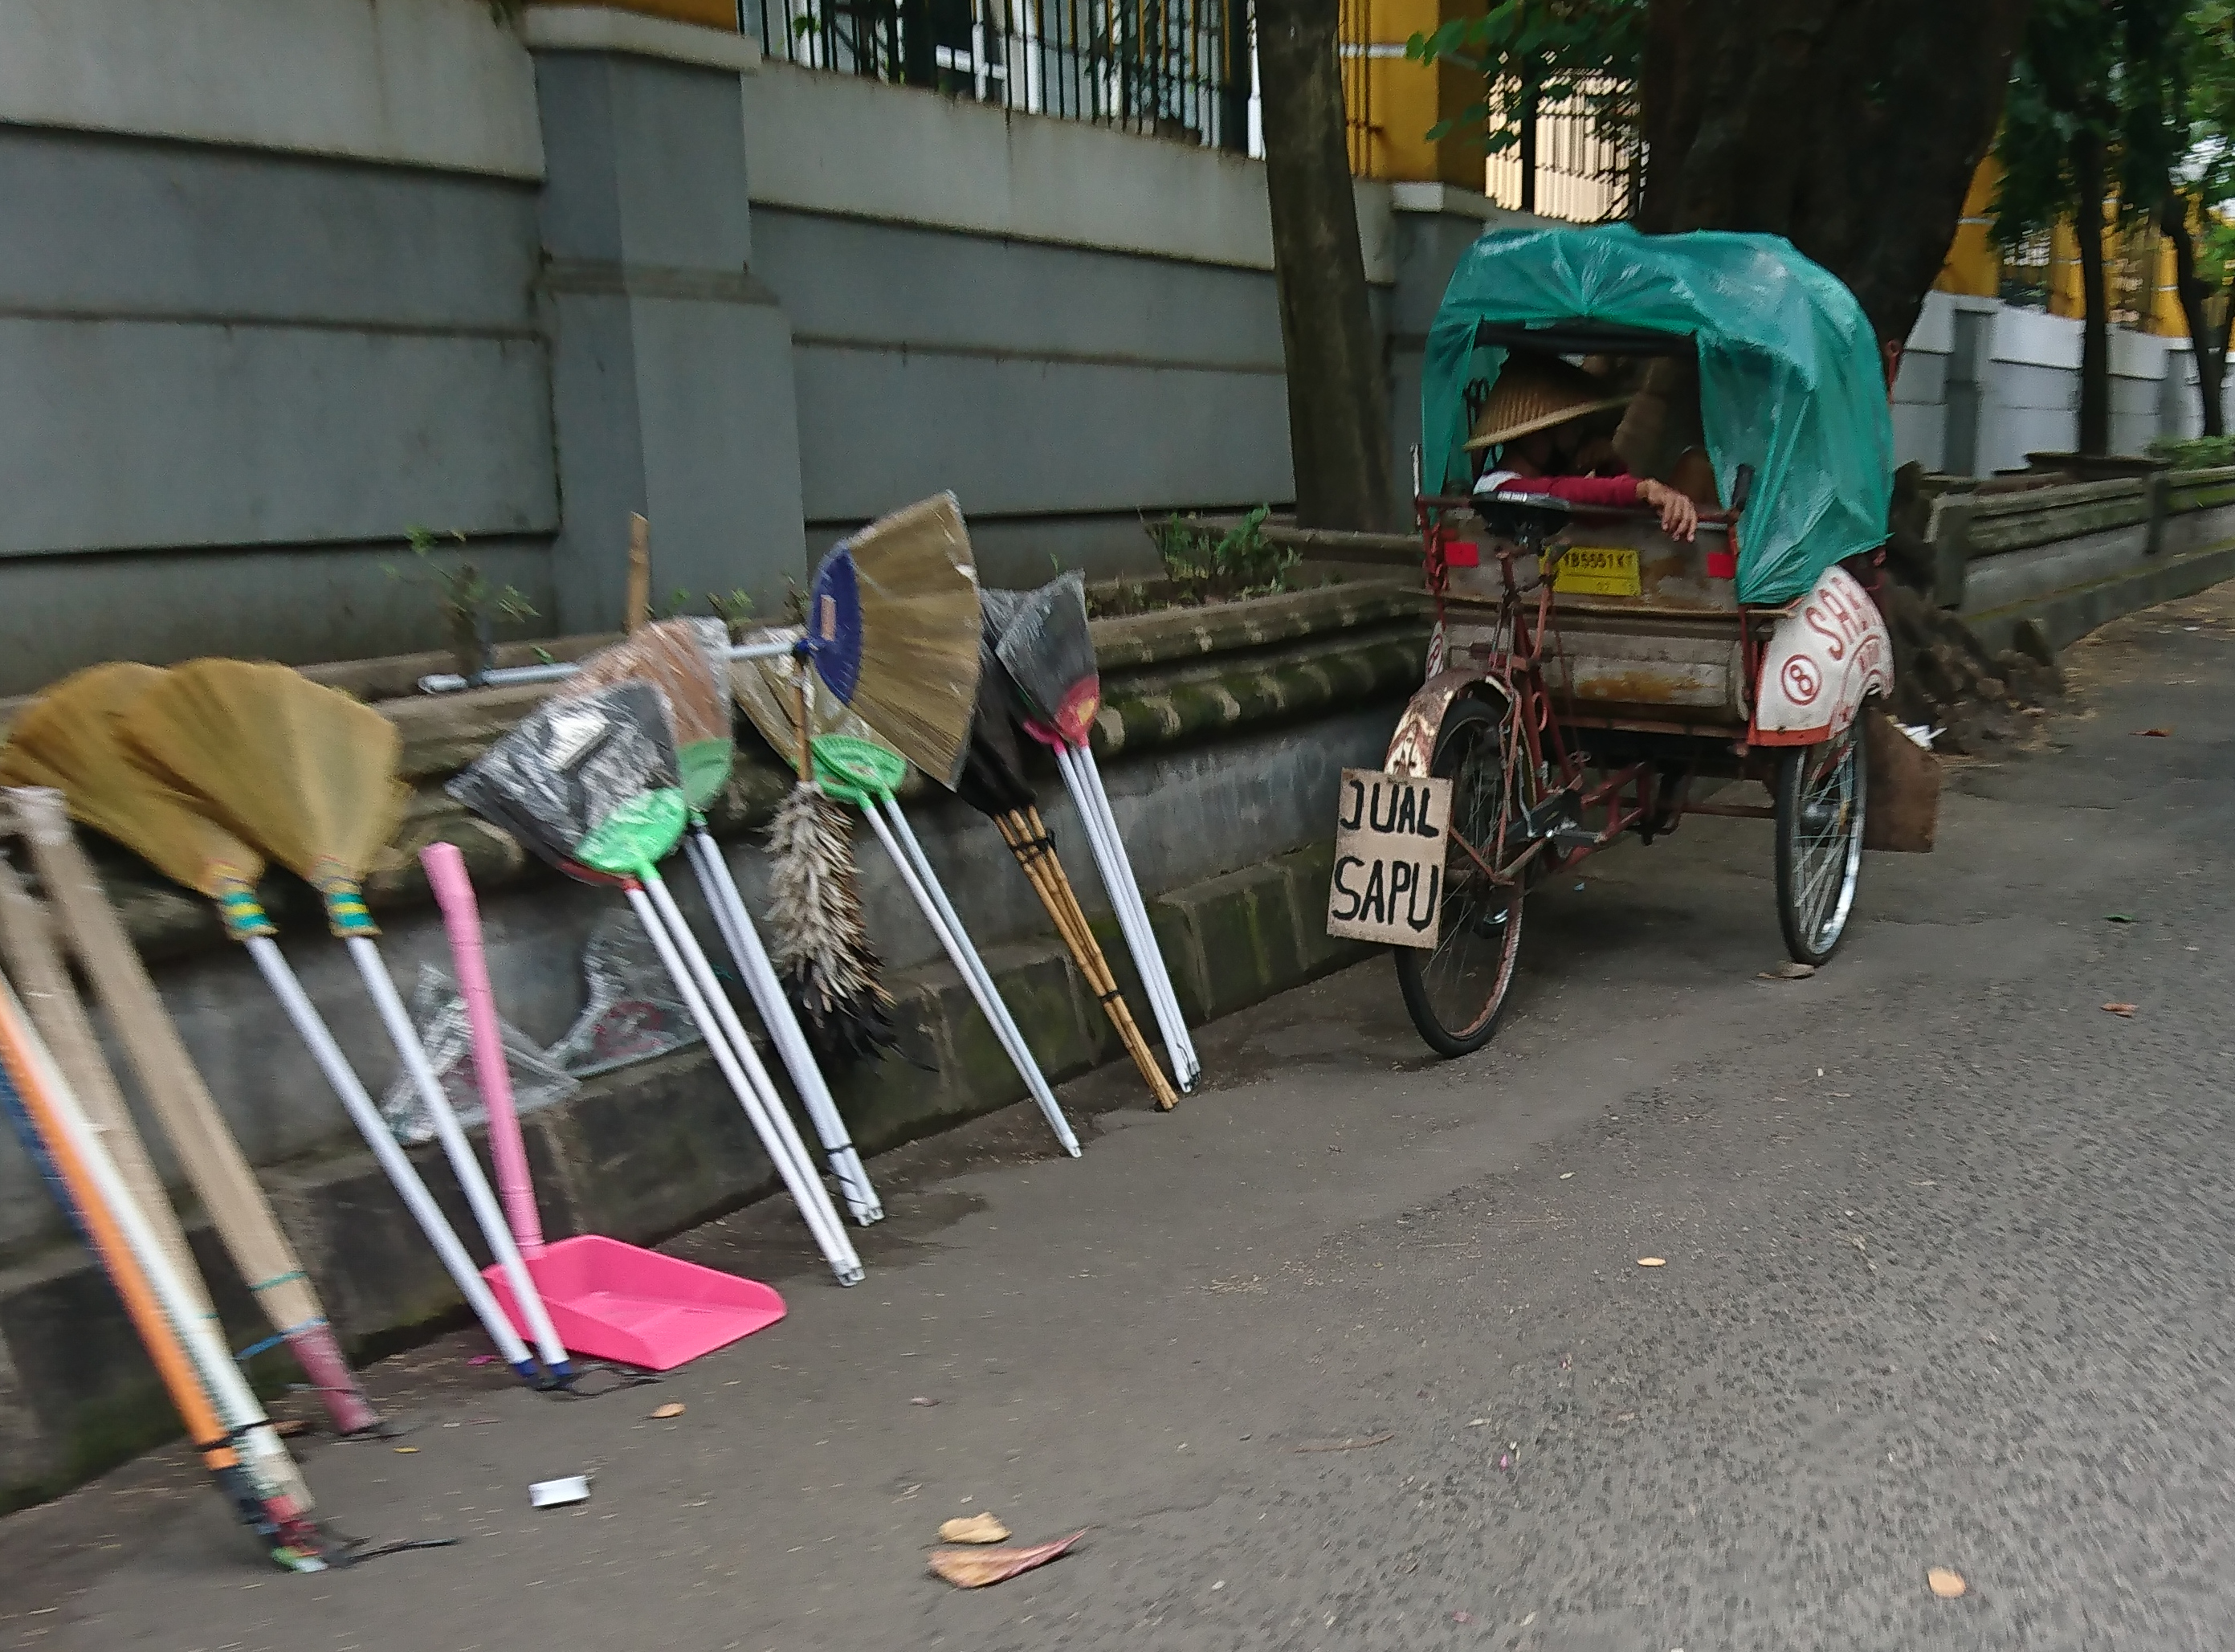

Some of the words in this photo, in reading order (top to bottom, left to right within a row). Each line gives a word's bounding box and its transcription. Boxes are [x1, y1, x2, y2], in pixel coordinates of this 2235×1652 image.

[1790, 664, 1813, 697] 8
[1340, 779, 1440, 838] JUAL
[1331, 855, 1439, 933] SAPU
